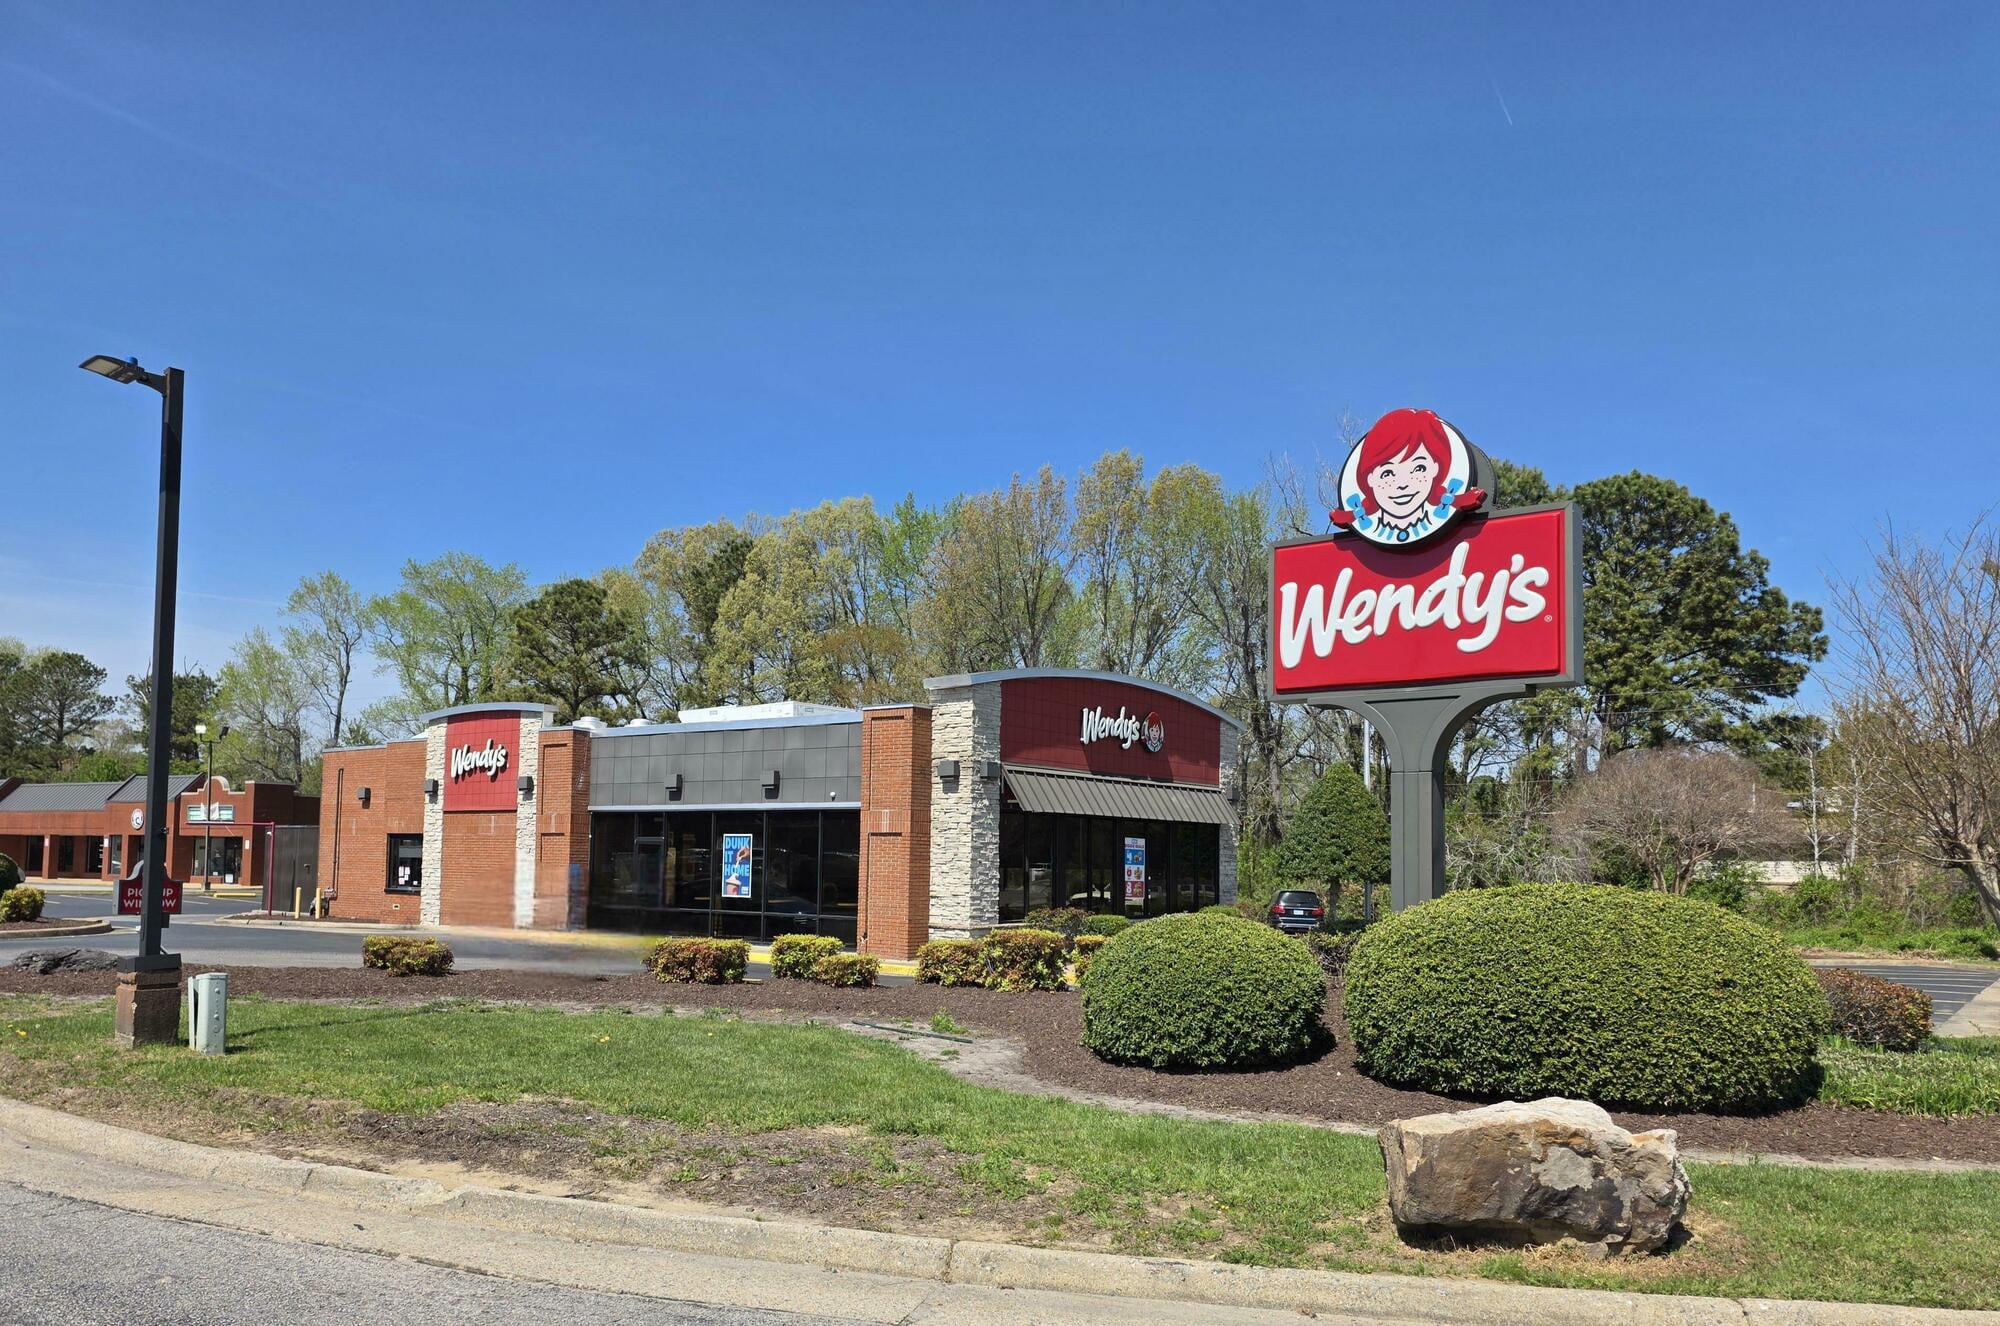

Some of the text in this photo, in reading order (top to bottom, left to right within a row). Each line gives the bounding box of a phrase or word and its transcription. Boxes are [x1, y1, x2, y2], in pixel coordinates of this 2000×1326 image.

[1280, 541, 1549, 669] Wendy's
[1083, 706, 1140, 749] Wendy's
[451, 738, 507, 778] Wendy's
[725, 837, 750, 849] DUNK
[725, 851, 734, 863] IT
[725, 864, 750, 876] HOME
